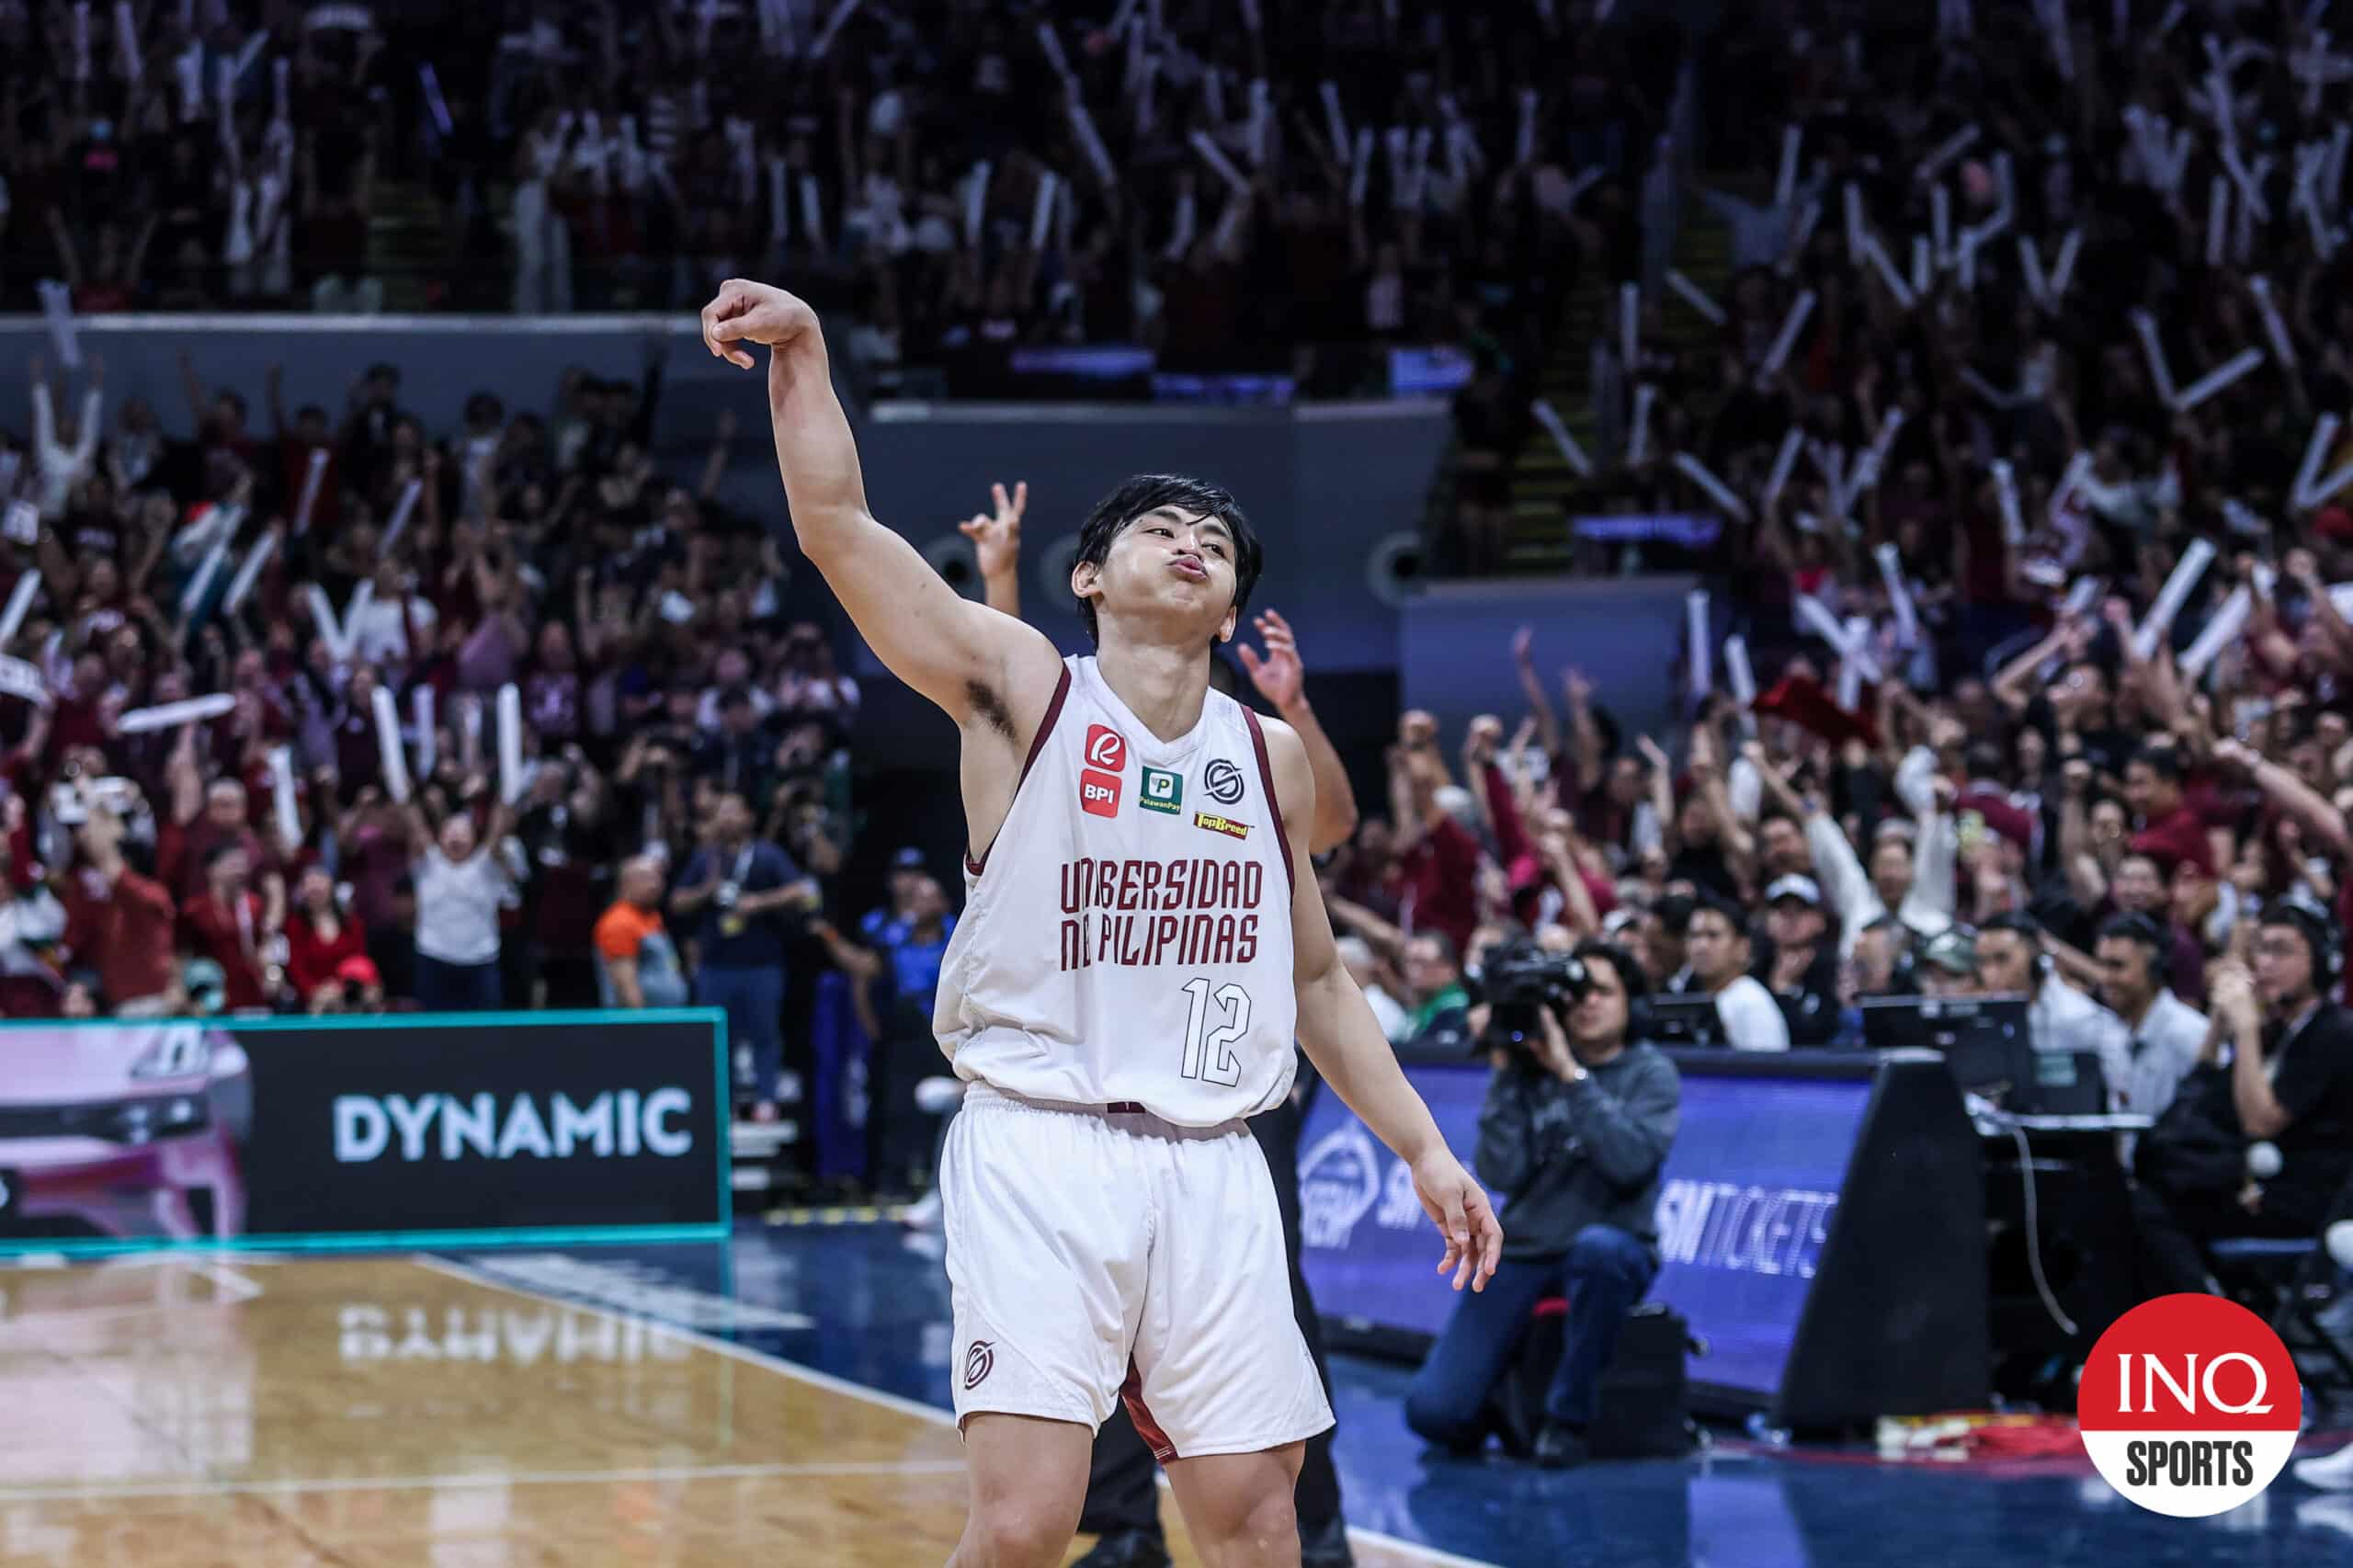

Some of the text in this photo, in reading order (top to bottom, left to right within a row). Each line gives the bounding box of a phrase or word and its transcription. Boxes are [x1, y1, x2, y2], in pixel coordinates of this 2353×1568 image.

[1085, 783, 1115, 804] BPI
[1197, 812, 1247, 835] TopBreed
[1098, 914, 1258, 966] PILIPINAS
[1181, 977, 1251, 1087] 12
[333, 1086, 693, 1163] DYNAMIC
